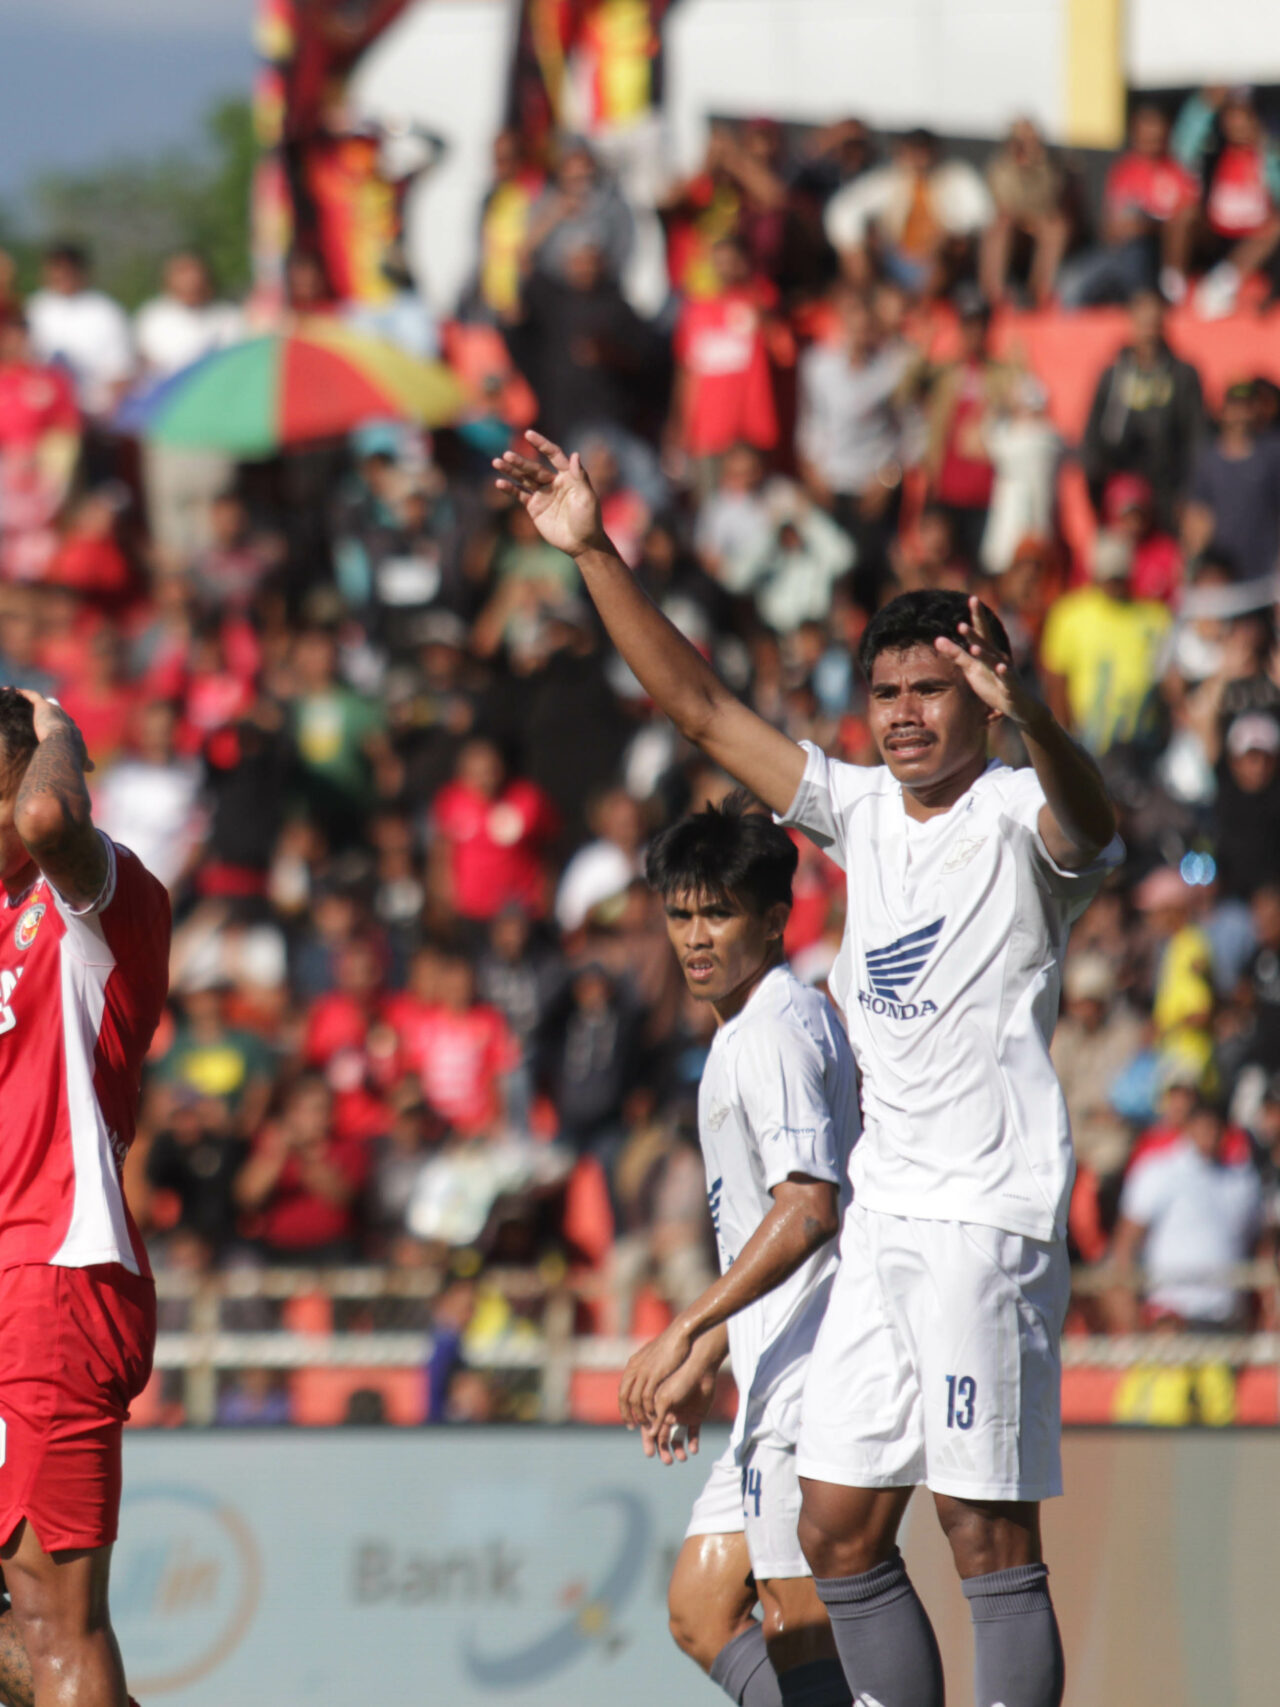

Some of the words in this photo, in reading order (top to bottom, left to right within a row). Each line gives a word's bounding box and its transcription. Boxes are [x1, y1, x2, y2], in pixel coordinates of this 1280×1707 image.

[858, 989, 938, 1021] HONDA
[945, 1374, 977, 1430] 13
[348, 1537, 522, 1606] Bank
